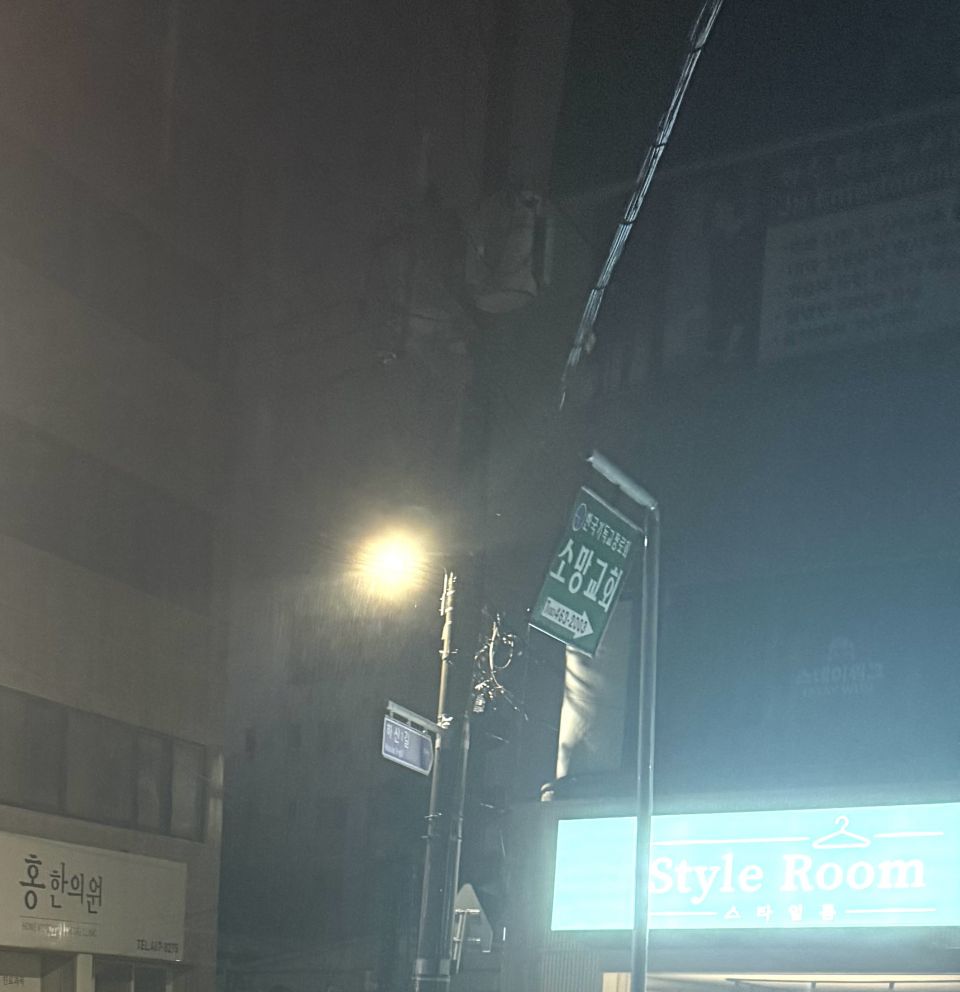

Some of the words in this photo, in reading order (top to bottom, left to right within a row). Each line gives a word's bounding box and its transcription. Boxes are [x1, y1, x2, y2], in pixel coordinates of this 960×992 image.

[550, 538, 624, 613] 소망교회
[19, 854, 103, 914] 홍한의원
[649, 853, 764, 905] Style
[780, 854, 926, 892] Room
